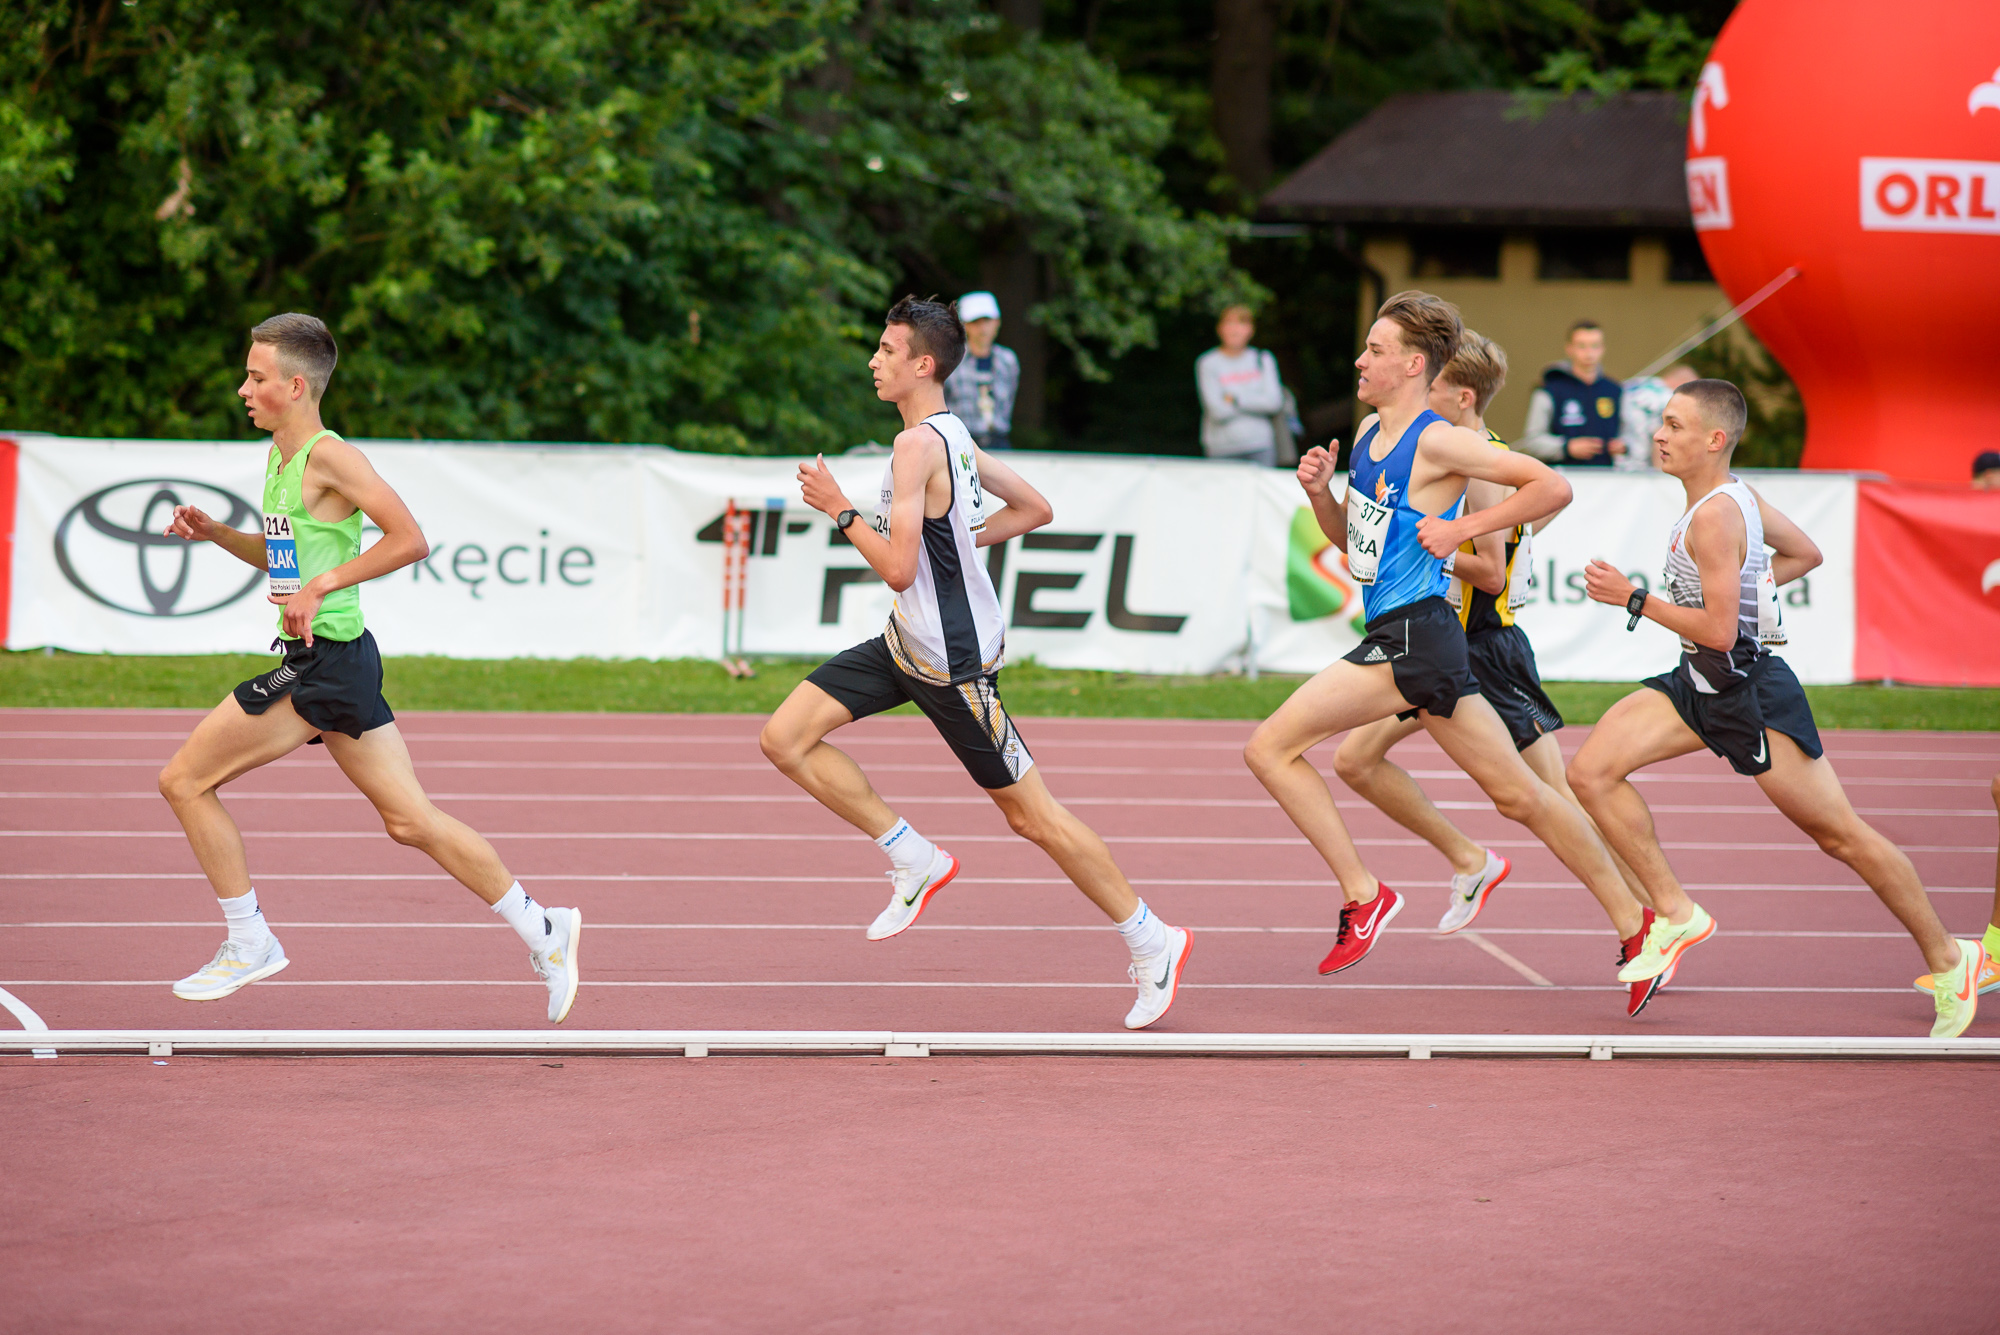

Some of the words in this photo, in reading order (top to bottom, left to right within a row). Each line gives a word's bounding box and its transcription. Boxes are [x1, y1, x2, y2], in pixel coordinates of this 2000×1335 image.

[1874, 171, 1997, 220] ORL
[266, 517, 290, 535] 214
[1360, 502, 1387, 527] 377
[266, 545, 296, 569] ŚLAK
[884, 825, 908, 847] VANS
